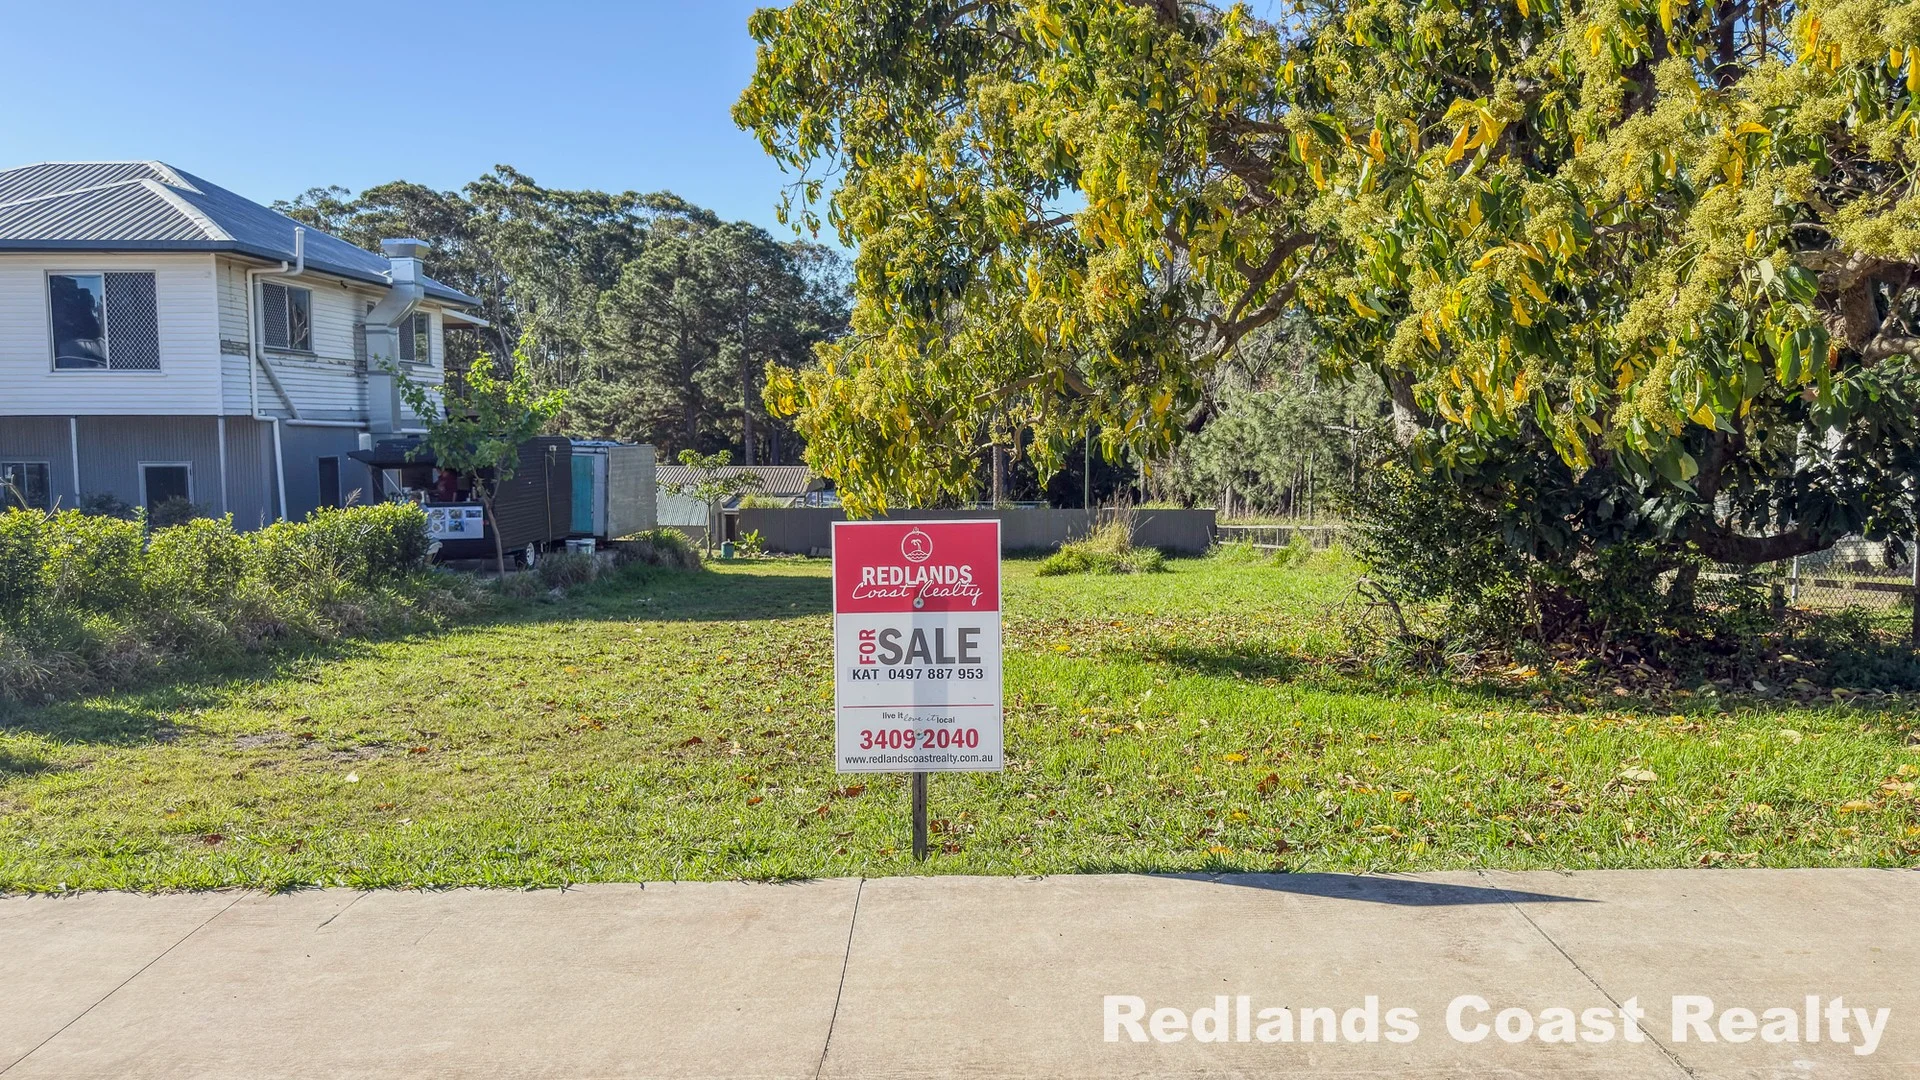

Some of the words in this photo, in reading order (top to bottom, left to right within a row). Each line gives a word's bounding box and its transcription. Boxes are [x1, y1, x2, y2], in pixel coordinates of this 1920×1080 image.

[862, 565, 973, 585] REDLANDS
[852, 582, 914, 600] Coast
[918, 579, 984, 606] Realty
[858, 628, 877, 665] FOR
[877, 627, 981, 666] SALE
[852, 668, 880, 680] KAT
[888, 668, 923, 680] 0497
[927, 668, 953, 680] 887
[958, 668, 984, 680] 953
[903, 713, 924, 722] love
[926, 713, 938, 722] it
[936, 716, 955, 724] local
[859, 729, 916, 750] 3409
[923, 728, 979, 749] 2040
[845, 752, 993, 764] www.redlandscoastrealty.com.au
